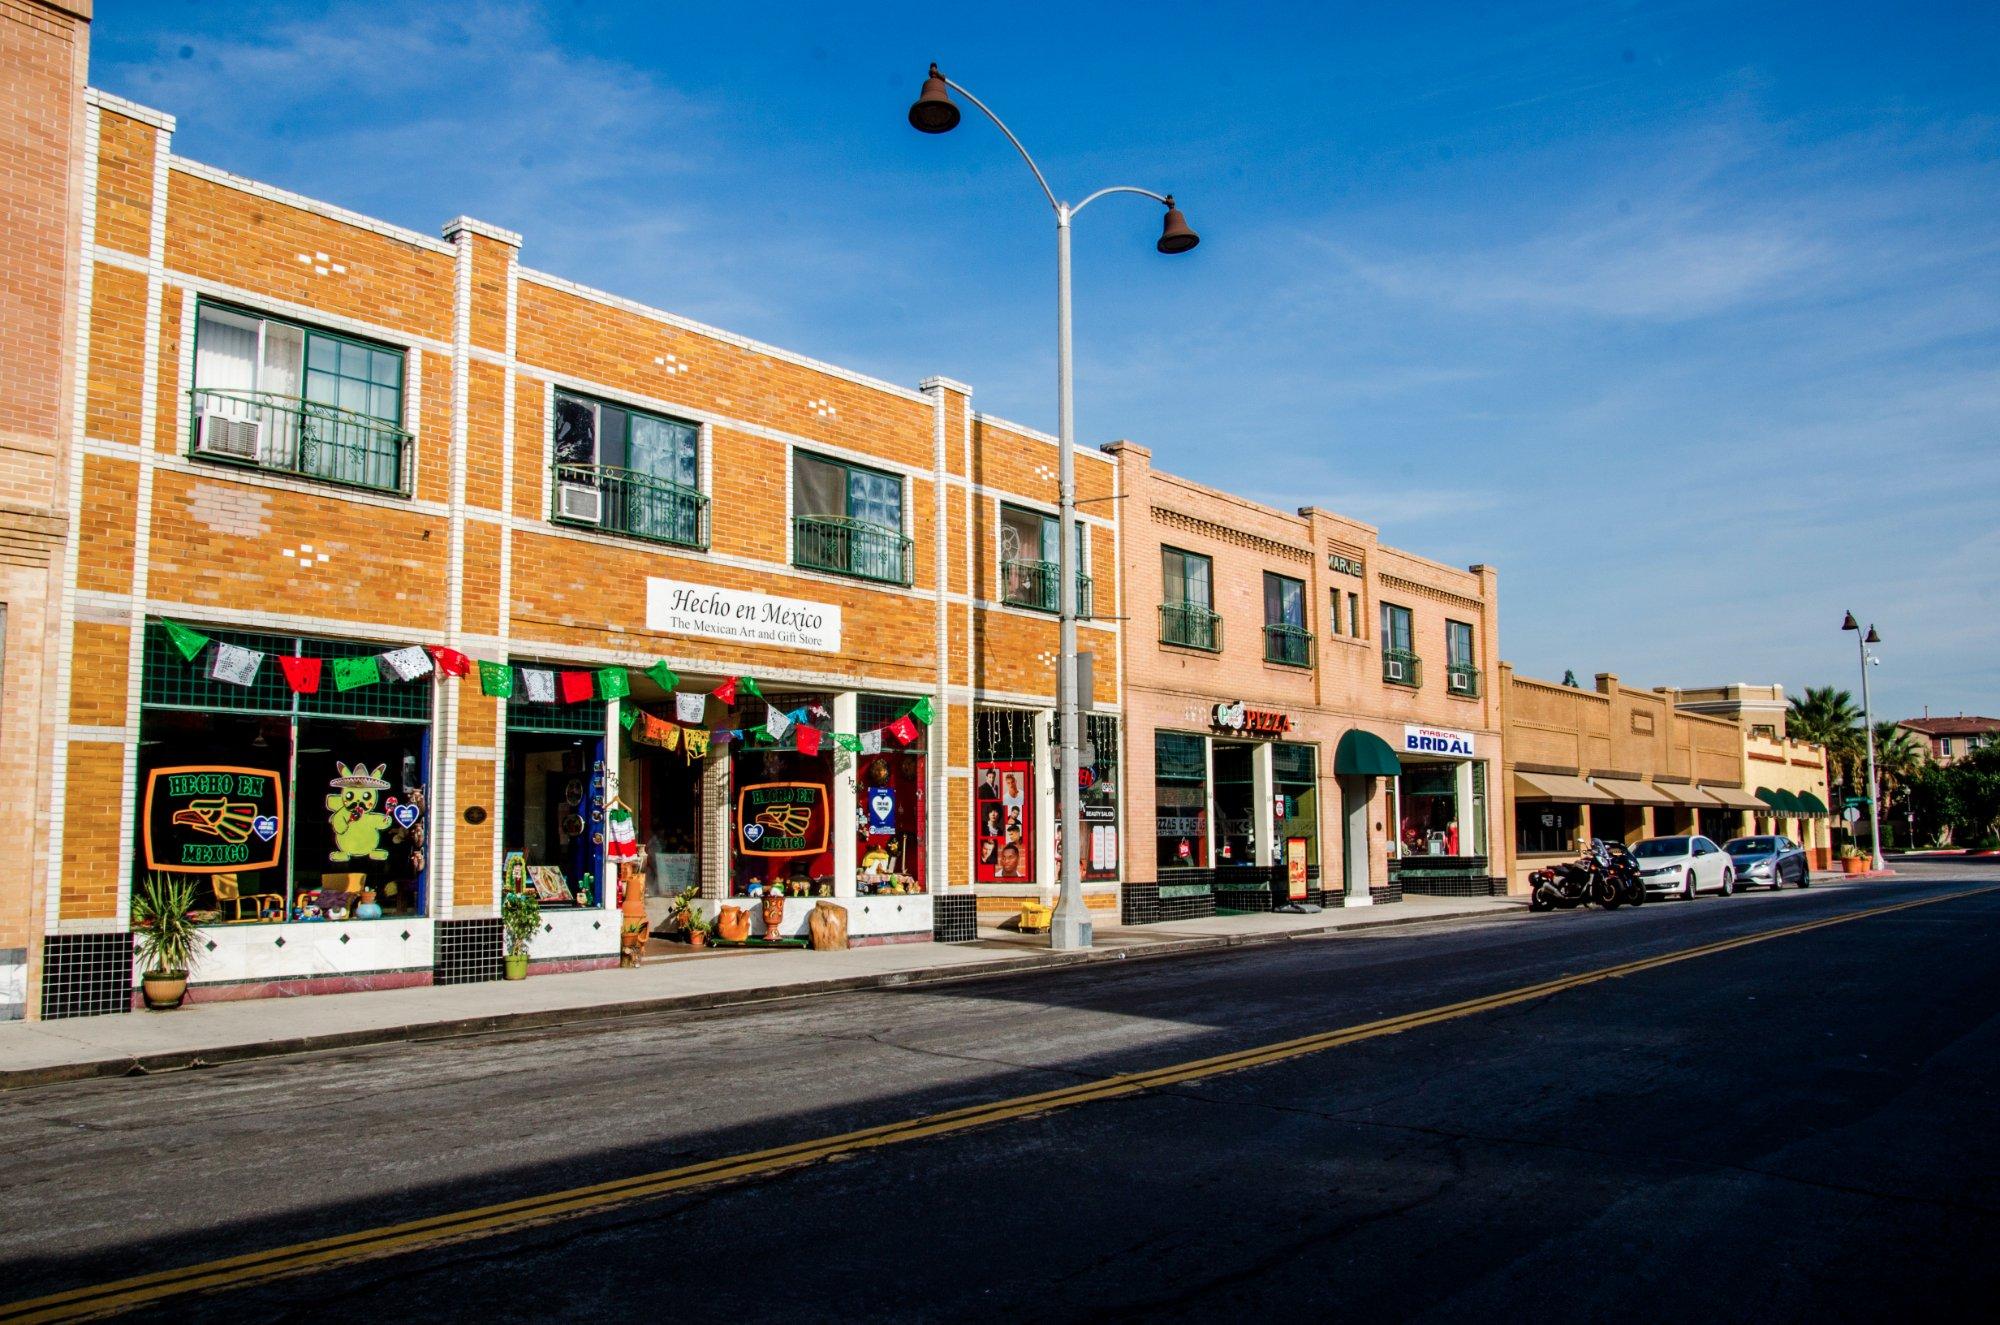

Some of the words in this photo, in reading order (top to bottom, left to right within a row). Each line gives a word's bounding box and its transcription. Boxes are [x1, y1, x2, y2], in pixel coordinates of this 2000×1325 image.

[1328, 555, 1362, 577] MARJIE
[670, 589, 730, 618] Hecho
[736, 603, 756, 620] en
[670, 616, 691, 630] The
[694, 619, 737, 636] Mexican
[739, 626, 755, 638] Art
[758, 629, 775, 641] and
[777, 630, 797, 643] Gift
[799, 633, 823, 646] Store
[1246, 710, 1292, 732] PIZZA
[1407, 735, 1473, 754] BRIDAL
[169, 774, 233, 796] HECHO
[237, 776, 264, 797] EN
[182, 844, 248, 863] MEXICO
[762, 836, 806, 850] MEXICO
